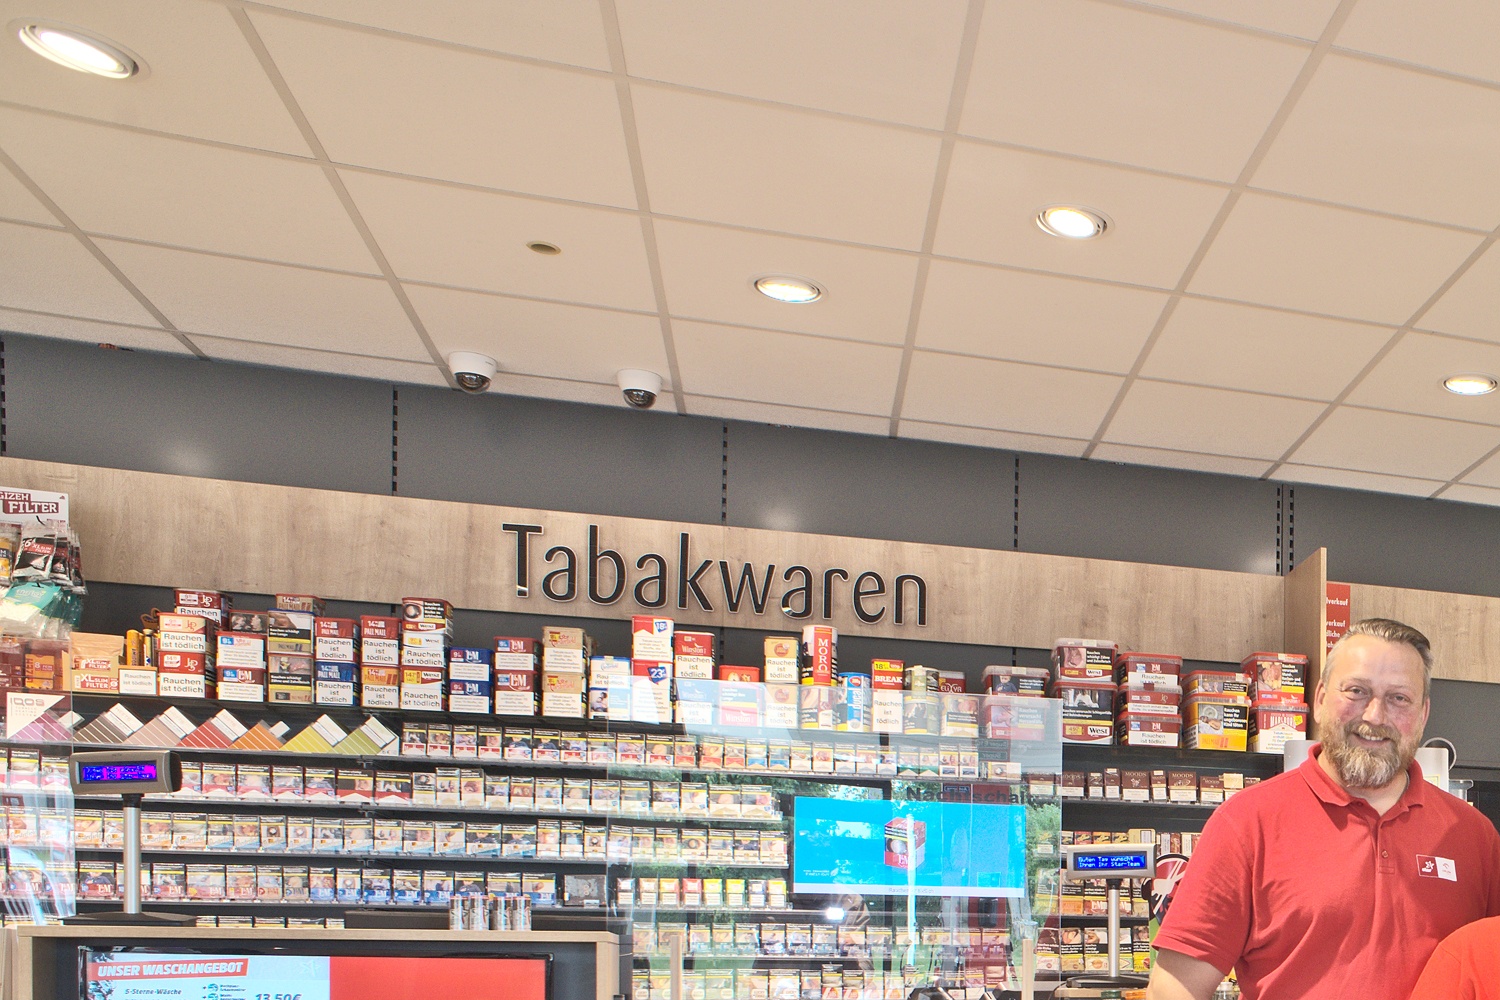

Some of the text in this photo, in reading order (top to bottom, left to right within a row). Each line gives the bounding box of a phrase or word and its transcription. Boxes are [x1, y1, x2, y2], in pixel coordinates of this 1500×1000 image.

[9, 501, 58, 514] FILTER
[501, 522, 929, 628] Tabakwaren
[681, 645, 704, 654] Winston
[407, 650, 440, 658] Rauchen
[818, 638, 829, 672] MORO
[416, 658, 442, 666] tödlich
[81, 674, 93, 683] XL
[163, 677, 201, 685] Rauchen
[875, 675, 903, 683] BREAK
[174, 685, 203, 693] tödlich
[876, 717, 899, 725] tödlich
[1089, 726, 1108, 734] West
[97, 962, 244, 977] UNSER WASCHANGEBOT
